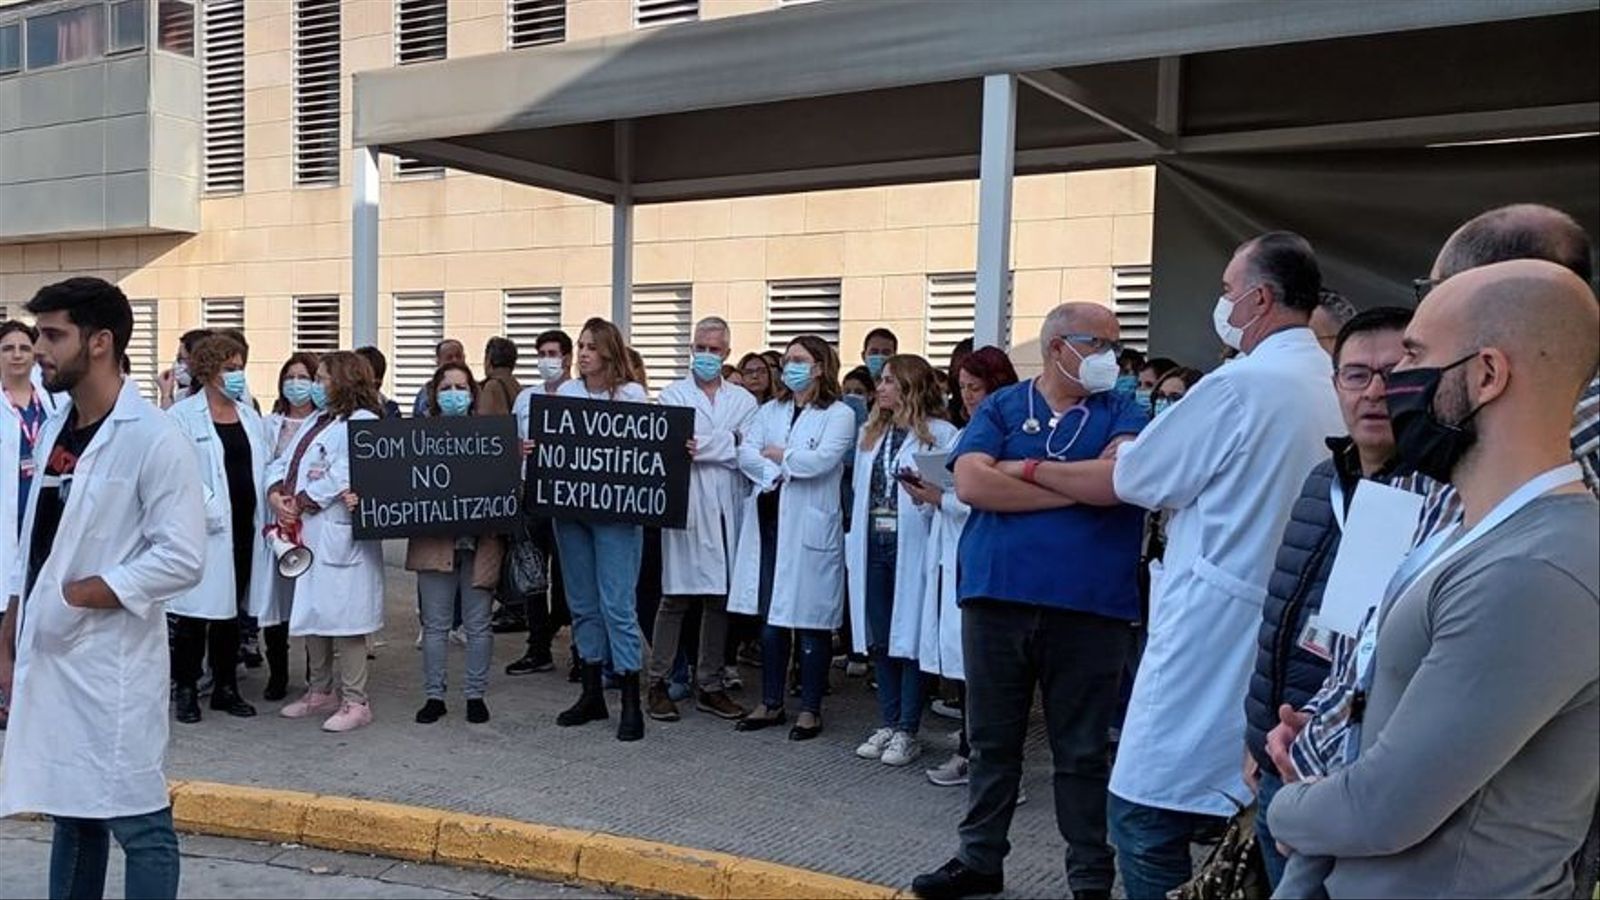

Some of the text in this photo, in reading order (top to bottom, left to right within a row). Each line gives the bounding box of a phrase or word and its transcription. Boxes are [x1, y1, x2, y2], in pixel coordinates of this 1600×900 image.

[544, 409, 668, 441] LA VOCACIÓ
[411, 464, 451, 489] NO
[538, 444, 666, 477] NO JUSTIFICA
[537, 479, 667, 515] L'EXPLOTACIÓ
